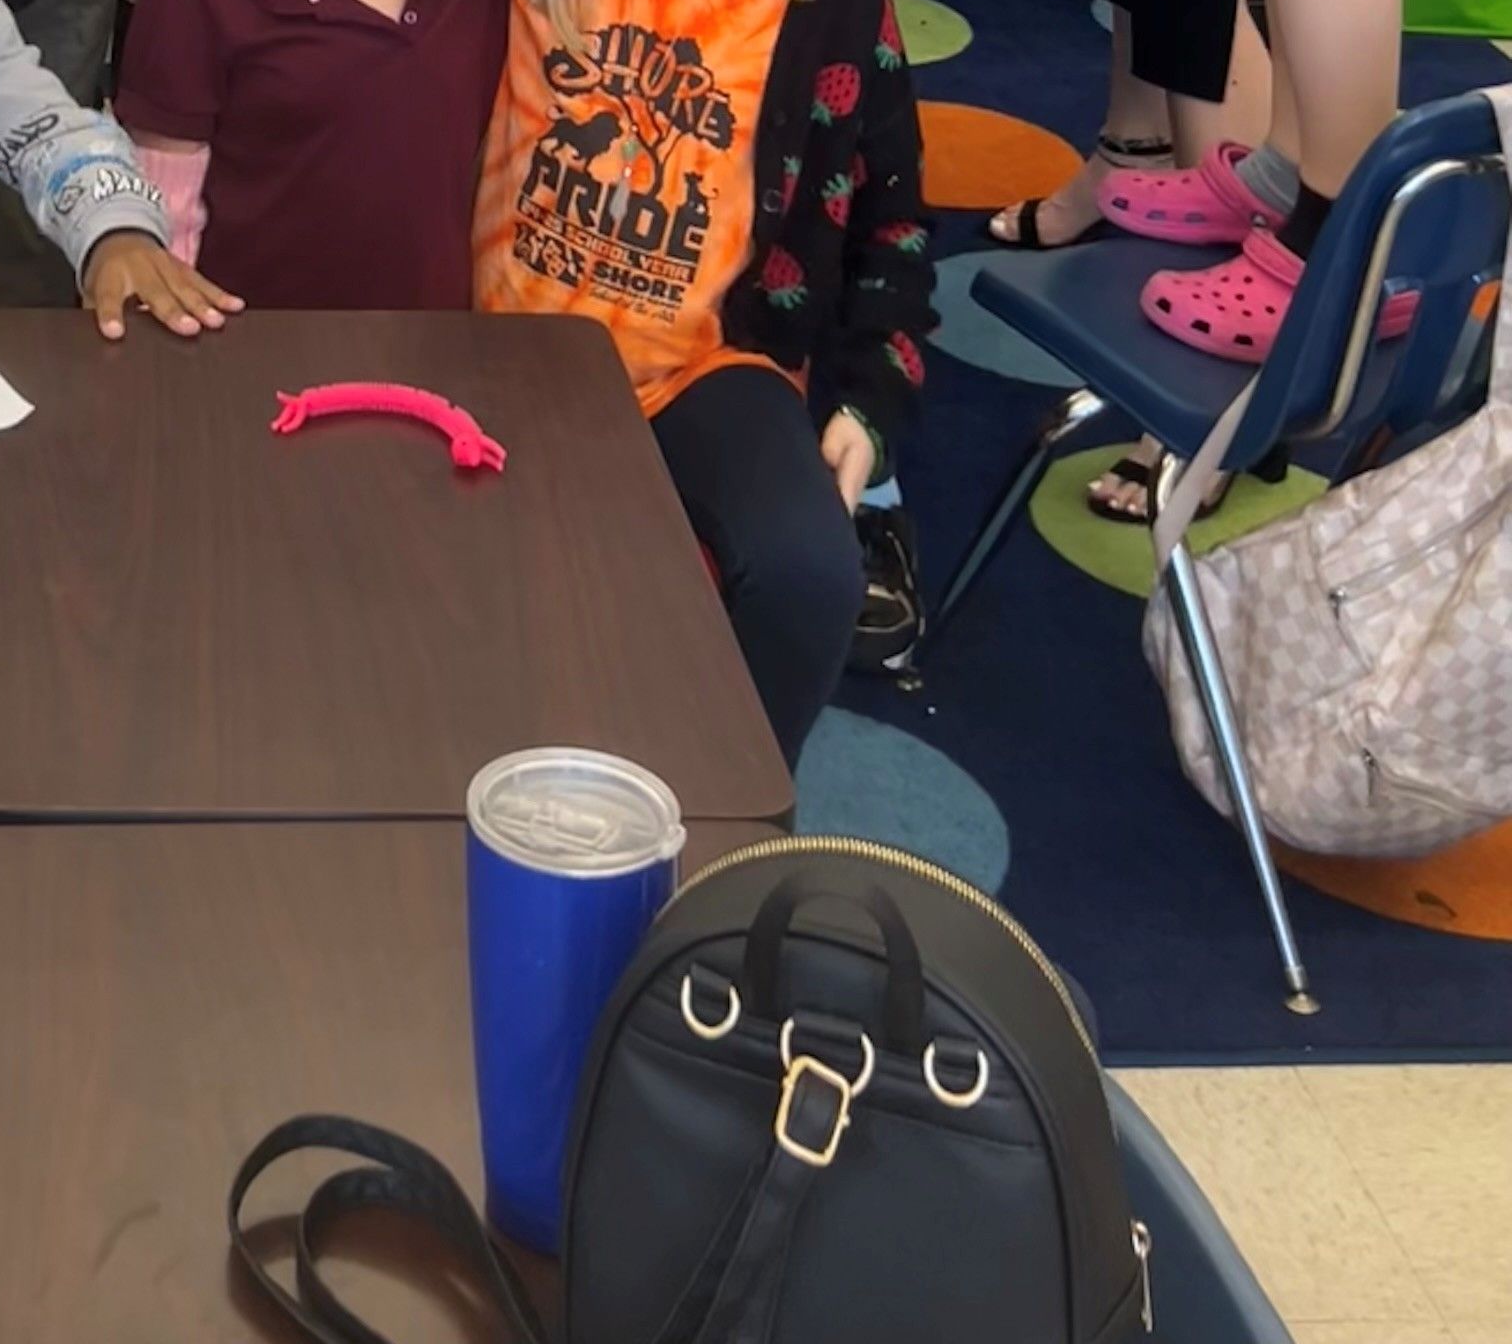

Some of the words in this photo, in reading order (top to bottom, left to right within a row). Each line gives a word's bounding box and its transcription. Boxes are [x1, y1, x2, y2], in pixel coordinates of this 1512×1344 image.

[543, 24, 735, 151] SHORE
[520, 146, 711, 263] PRIDE
[593, 261, 685, 303] SHORE
